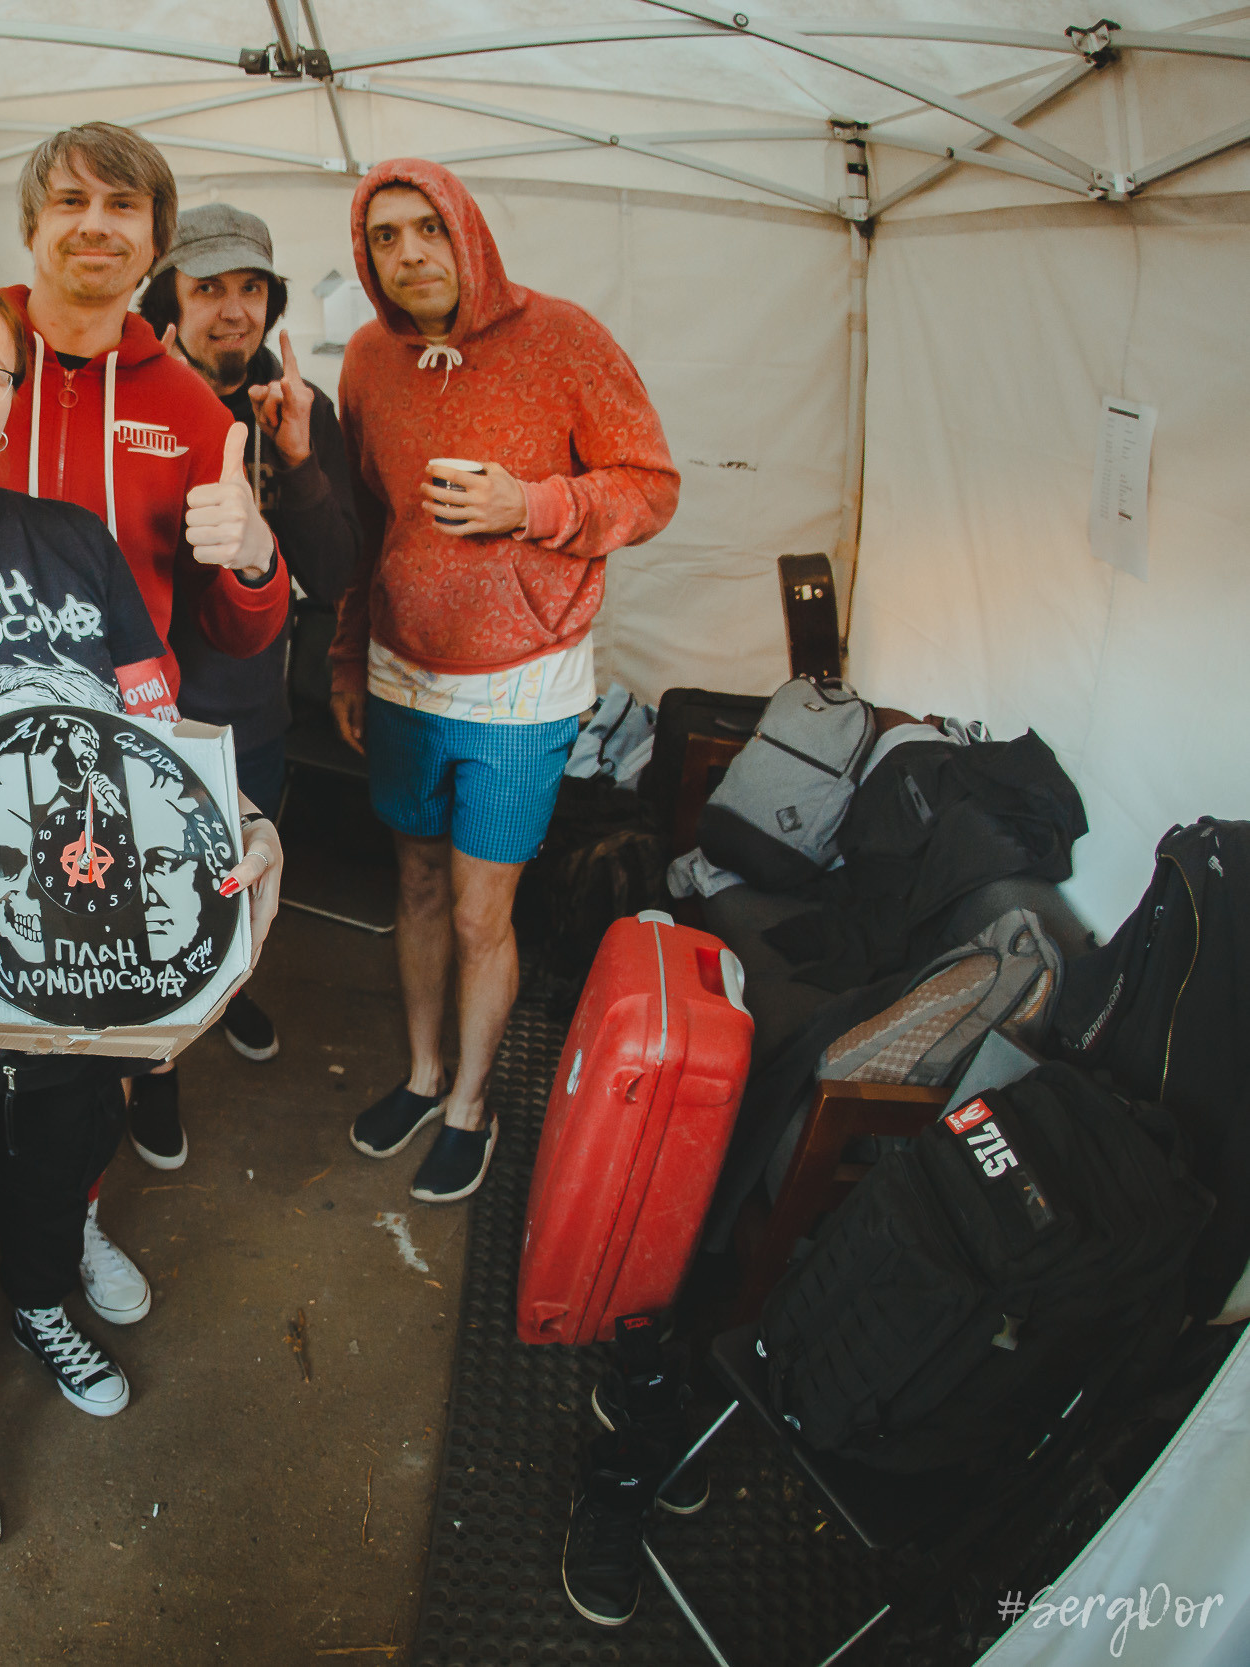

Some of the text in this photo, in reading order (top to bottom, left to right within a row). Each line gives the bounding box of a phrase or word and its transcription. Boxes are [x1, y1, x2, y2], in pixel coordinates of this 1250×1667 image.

[118, 424, 177, 453] PUMA
[55, 814, 66, 825] 11
[102, 818, 108, 828] 1
[39, 830, 52, 840] 10
[118, 834, 127, 845] 2
[36, 851, 45, 864] 9
[127, 855, 136, 868] 3
[45, 876, 54, 888] 8
[123, 877, 133, 890] 4
[63, 892, 72, 906] 7
[110, 894, 119, 907] 5
[87, 900, 96, 912] 6
[55, 938, 139, 969] ПЛАН
[17, 963, 187, 999] ЛОМОНОСОВА
[966, 1121, 1019, 1178] 715
